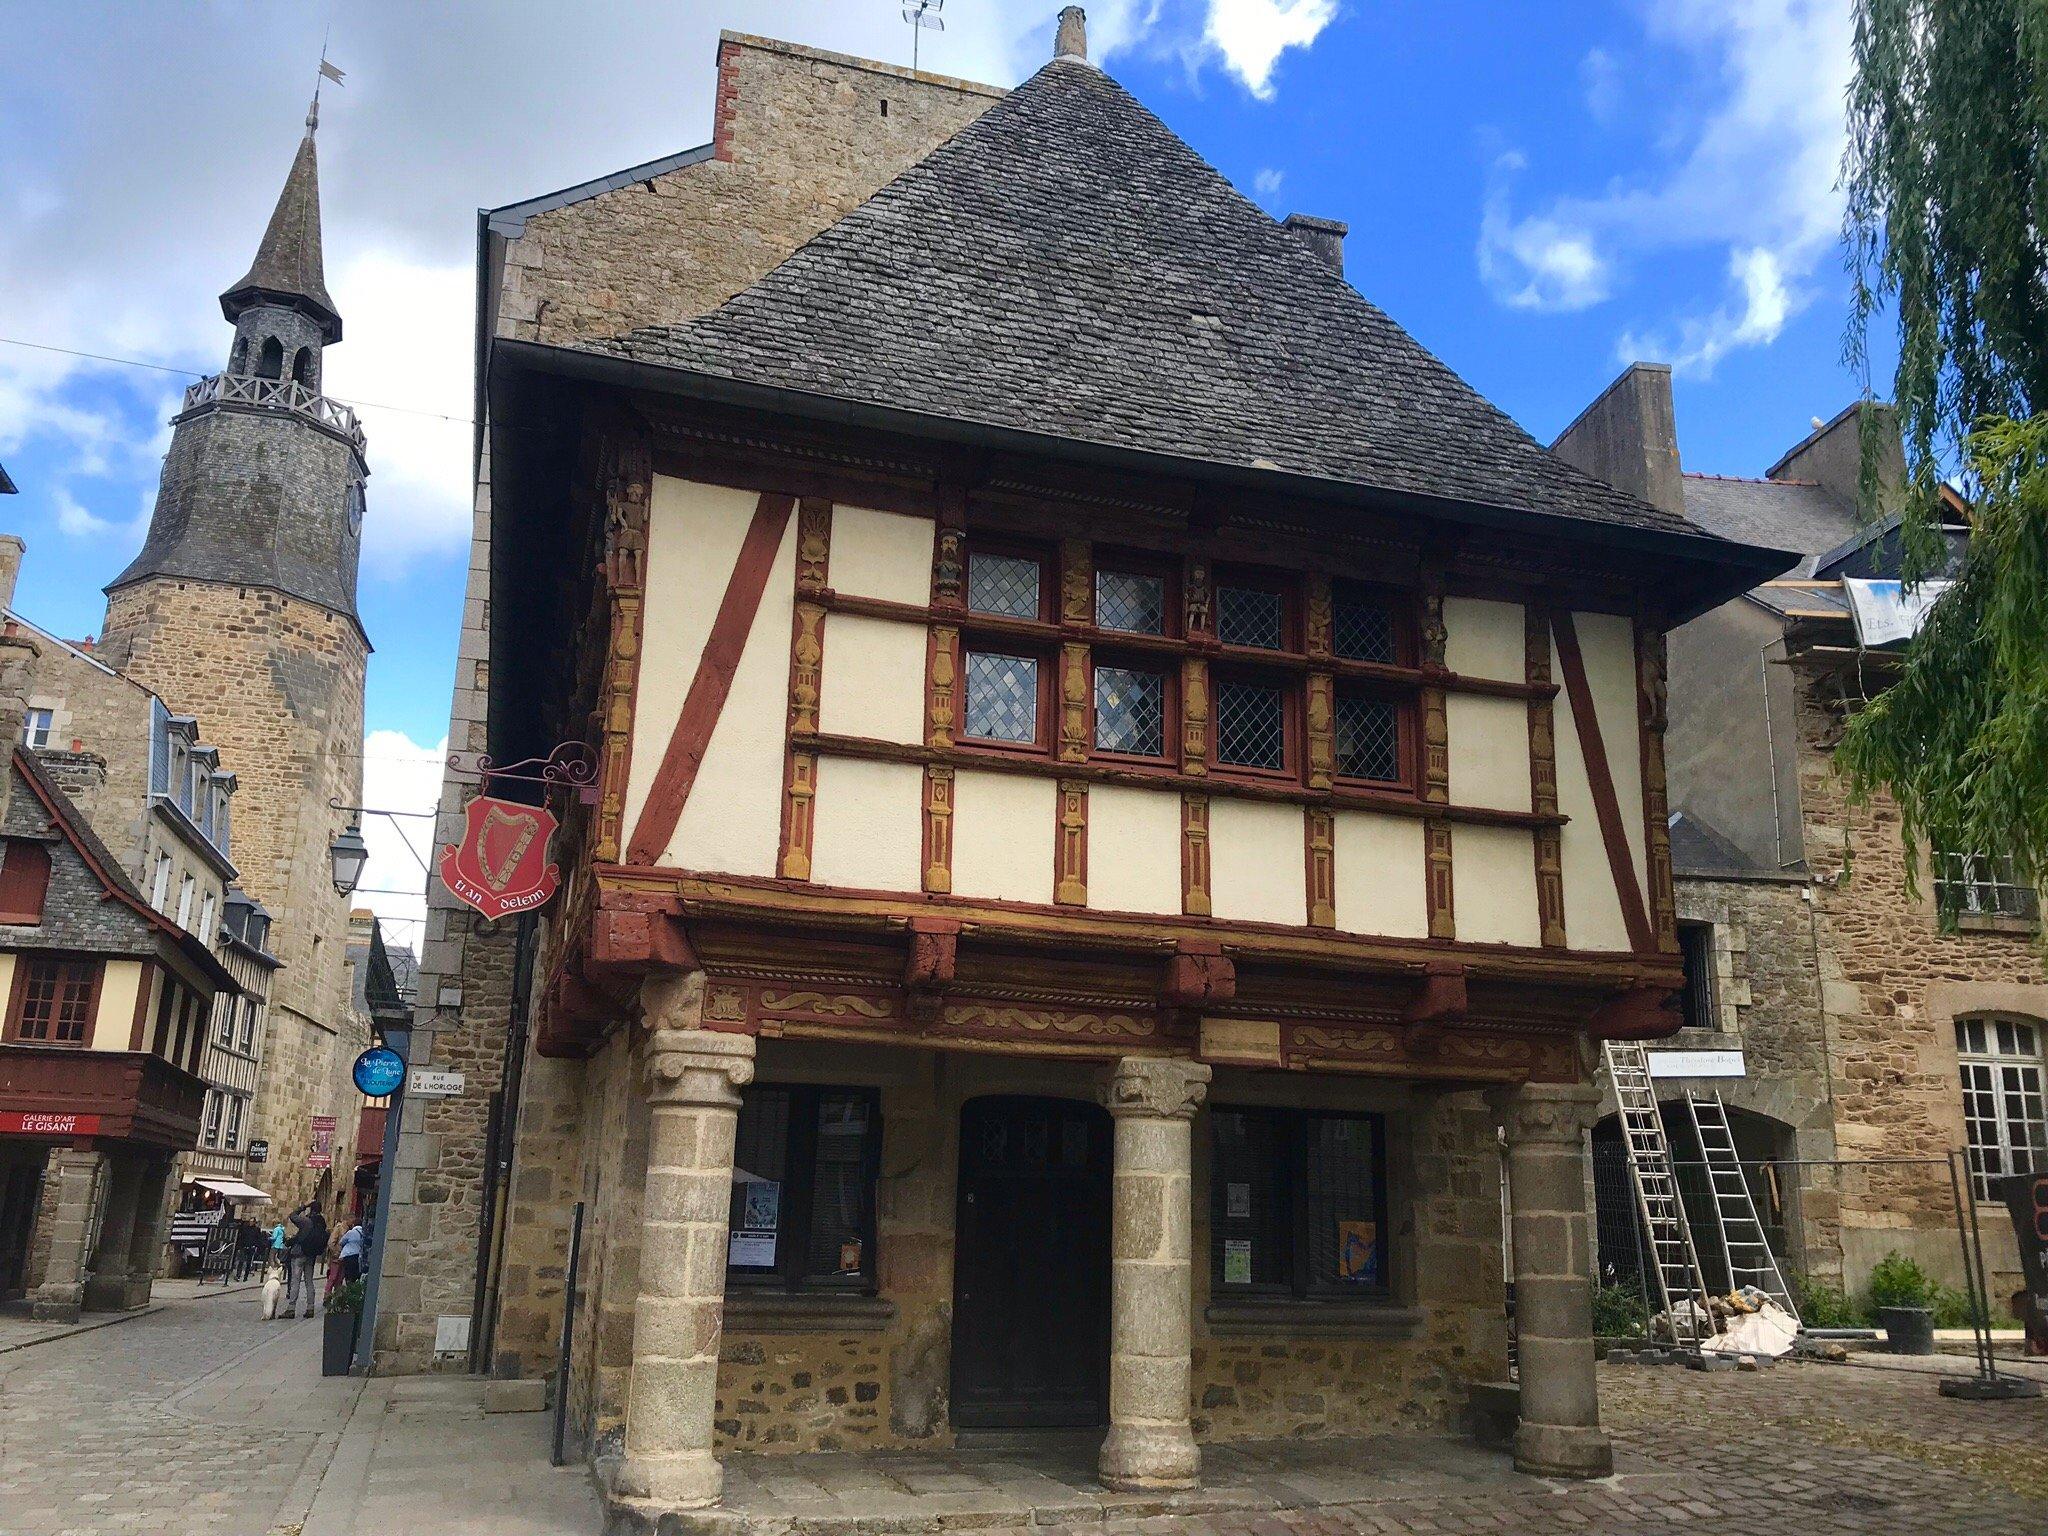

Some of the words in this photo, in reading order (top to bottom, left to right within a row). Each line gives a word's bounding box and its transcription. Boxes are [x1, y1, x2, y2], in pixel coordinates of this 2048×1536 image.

[466, 889, 483, 905] an
[500, 889, 546, 909] delenn
[361, 1057, 372, 1068] La
[373, 1058, 399, 1067] Pierre
[372, 1066, 381, 1074] de
[383, 1067, 401, 1077] Lune
[23, 1114, 53, 1122] GALERIE
[54, 1115, 77, 1123] D'ART
[21, 1121, 33, 1130] LE
[35, 1122, 76, 1132] GISANT
